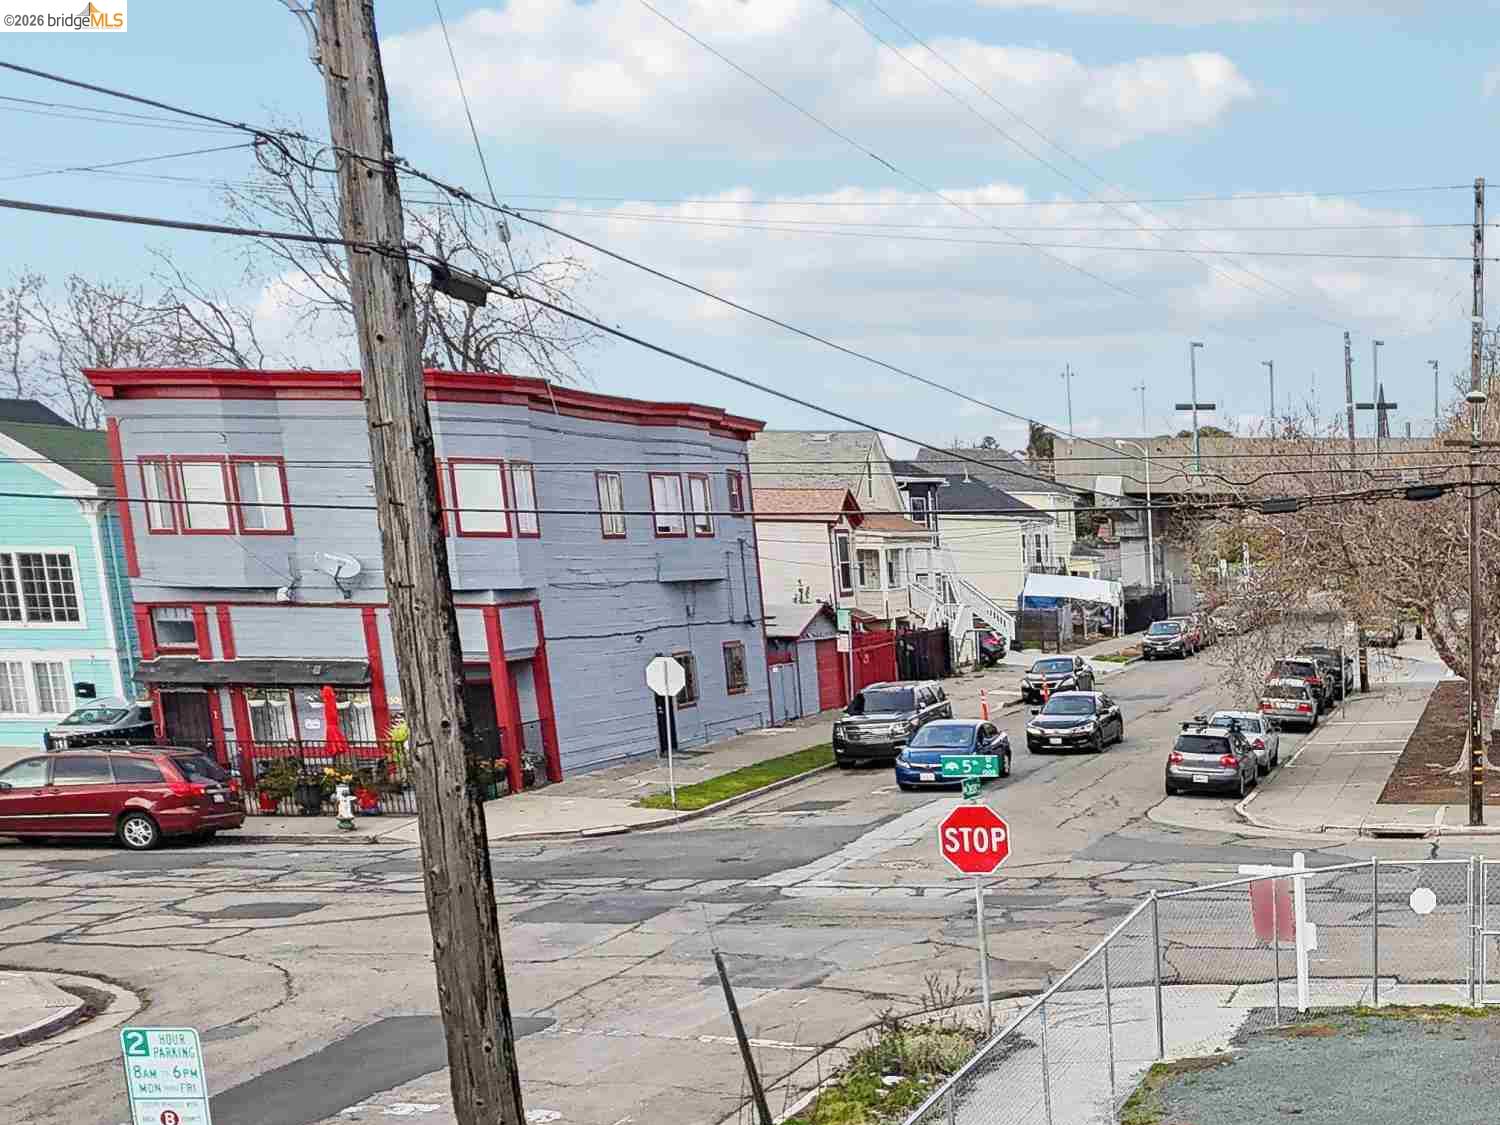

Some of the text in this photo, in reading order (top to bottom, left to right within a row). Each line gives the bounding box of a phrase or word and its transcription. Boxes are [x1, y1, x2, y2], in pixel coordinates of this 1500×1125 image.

[945, 827, 1005, 853] STOP
[127, 1032, 187, 1054] 2 HOUR
[153, 1047, 195, 1058] PARKING
[133, 1065, 157, 1078] 8AM
[172, 1065, 198, 1078] 6PM
[164, 1112, 174, 1125] B
